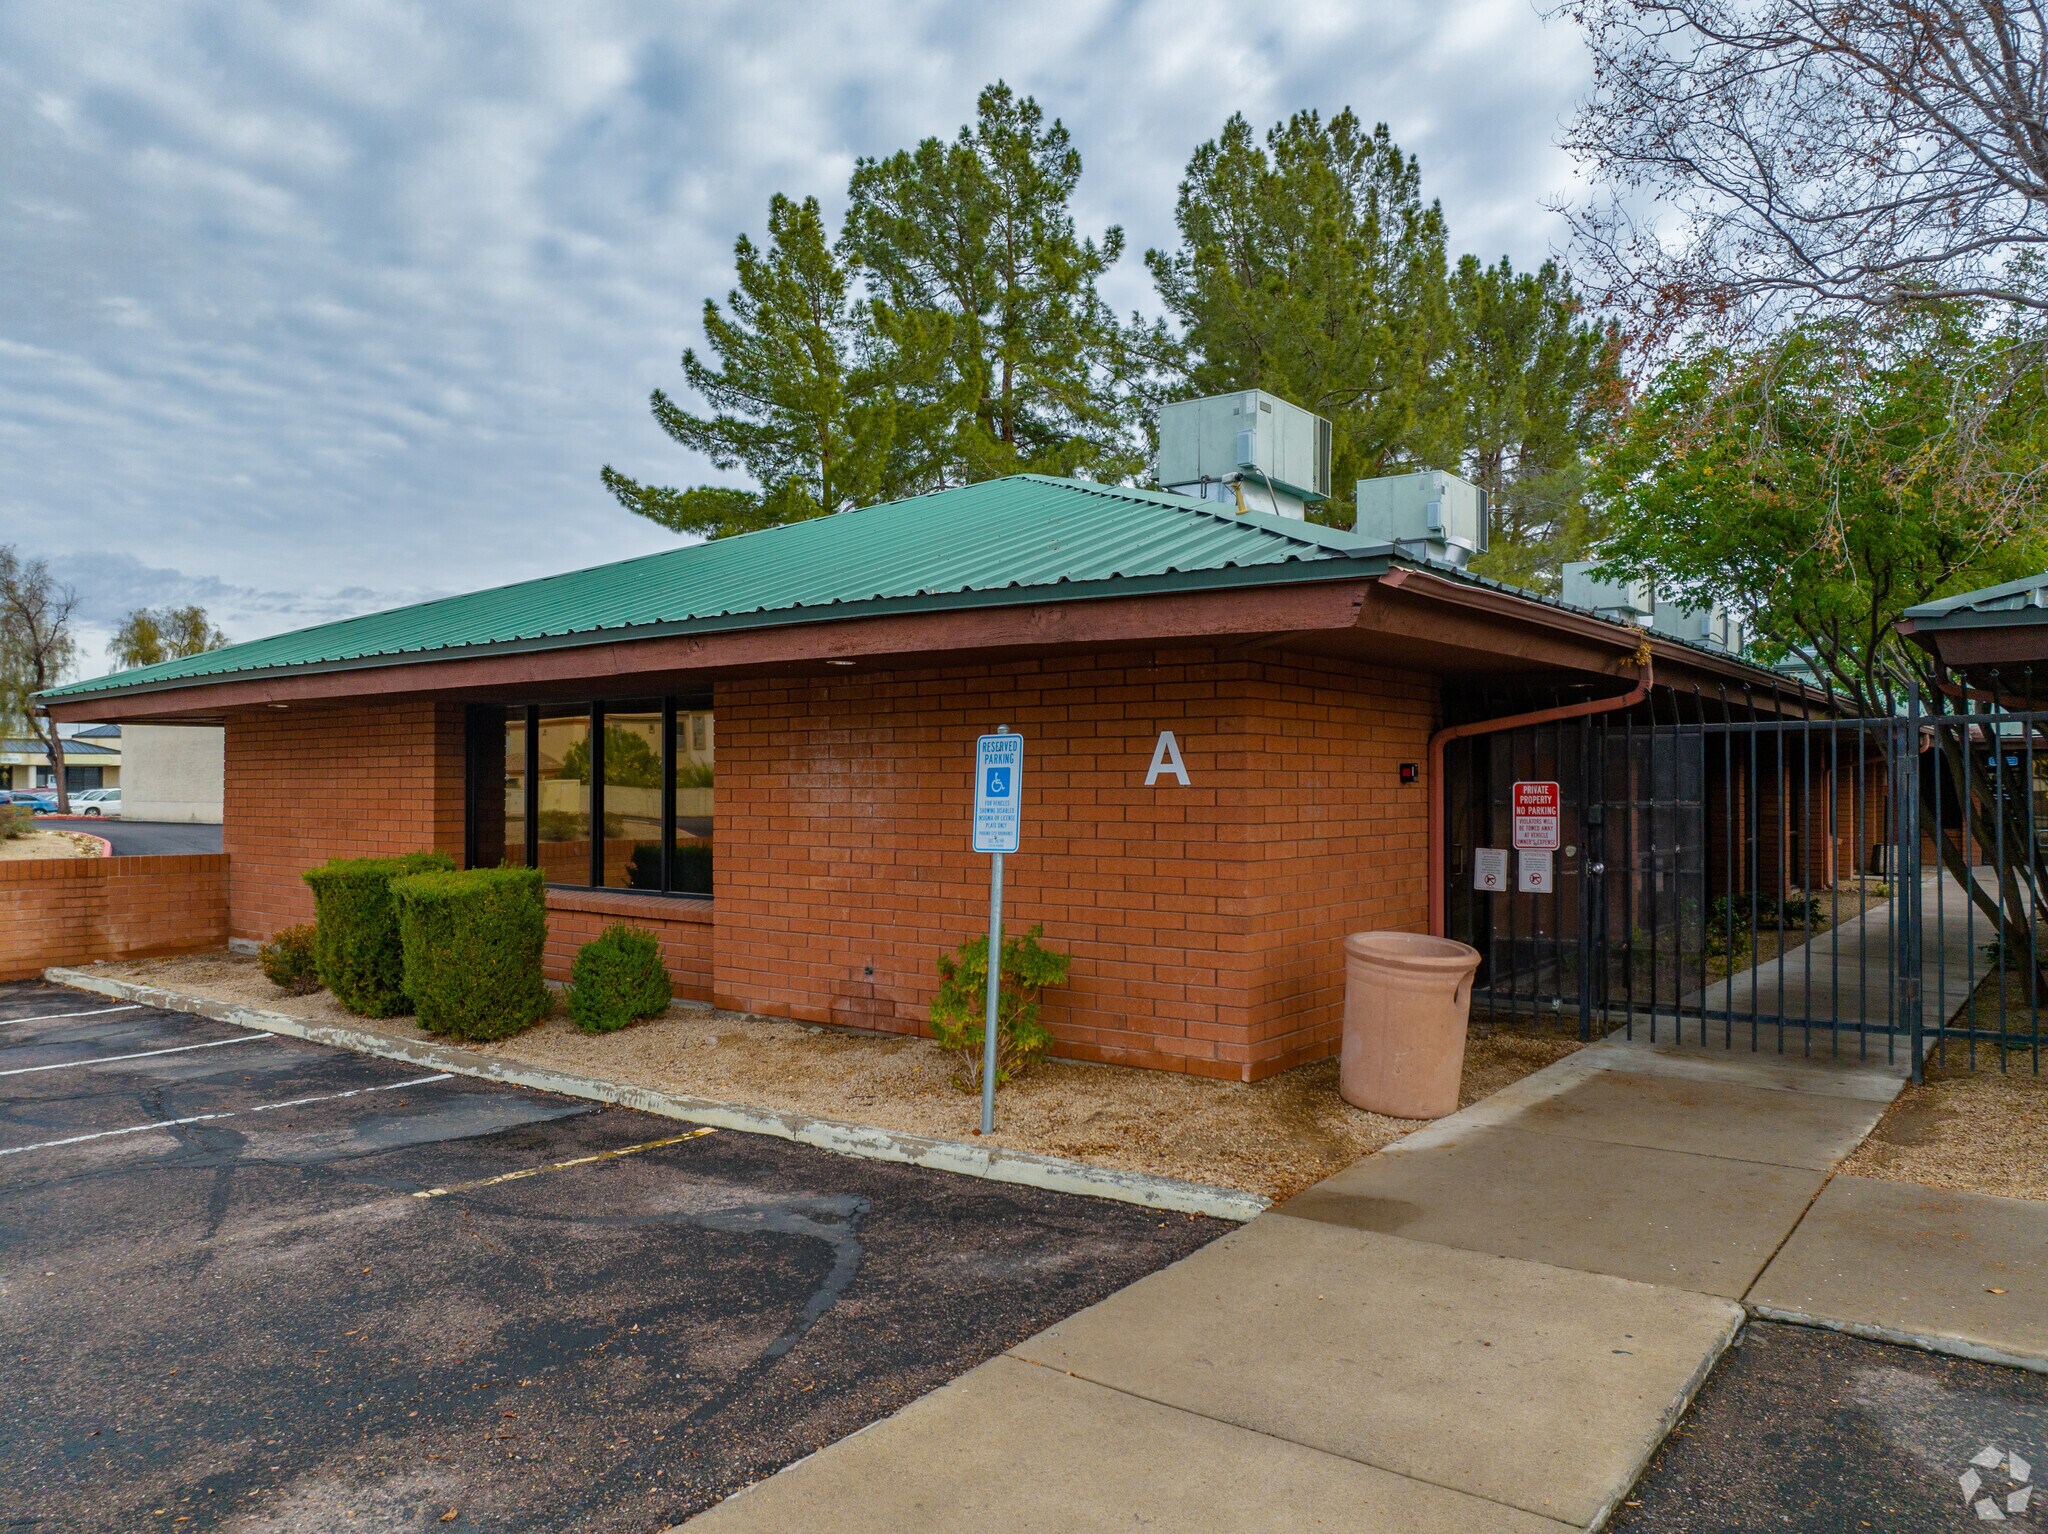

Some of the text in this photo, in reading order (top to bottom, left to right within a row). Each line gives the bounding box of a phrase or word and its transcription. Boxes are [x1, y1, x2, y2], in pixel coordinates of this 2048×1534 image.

[982, 741, 1017, 752] RESERVED
[984, 753, 1014, 764] PARKING
[1144, 731, 1191, 785] A
[1523, 785, 1549, 795] PRIVATE
[1519, 795, 1552, 804] PROPERTY
[1516, 806, 1557, 815] NO PARKING
